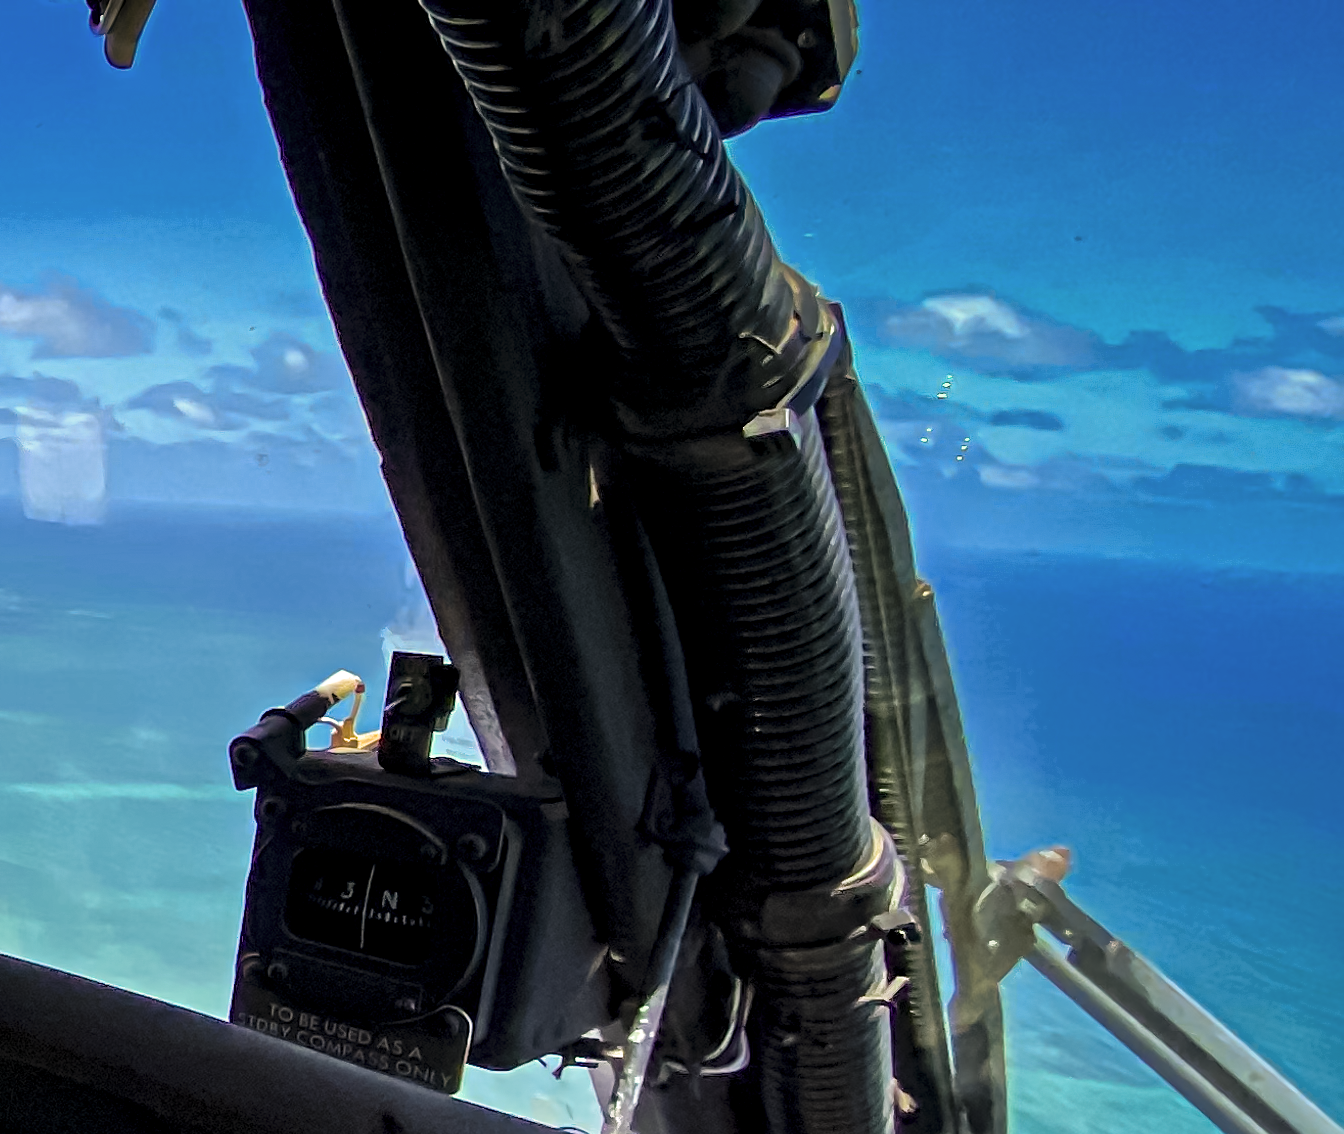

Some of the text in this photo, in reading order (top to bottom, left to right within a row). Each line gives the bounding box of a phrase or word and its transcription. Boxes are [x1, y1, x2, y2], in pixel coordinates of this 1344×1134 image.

[382, 889, 399, 911] N
[237, 1012, 453, 1088] STDBY COMPASS ONLY
[268, 1002, 423, 1062] TO BE USED AS A
